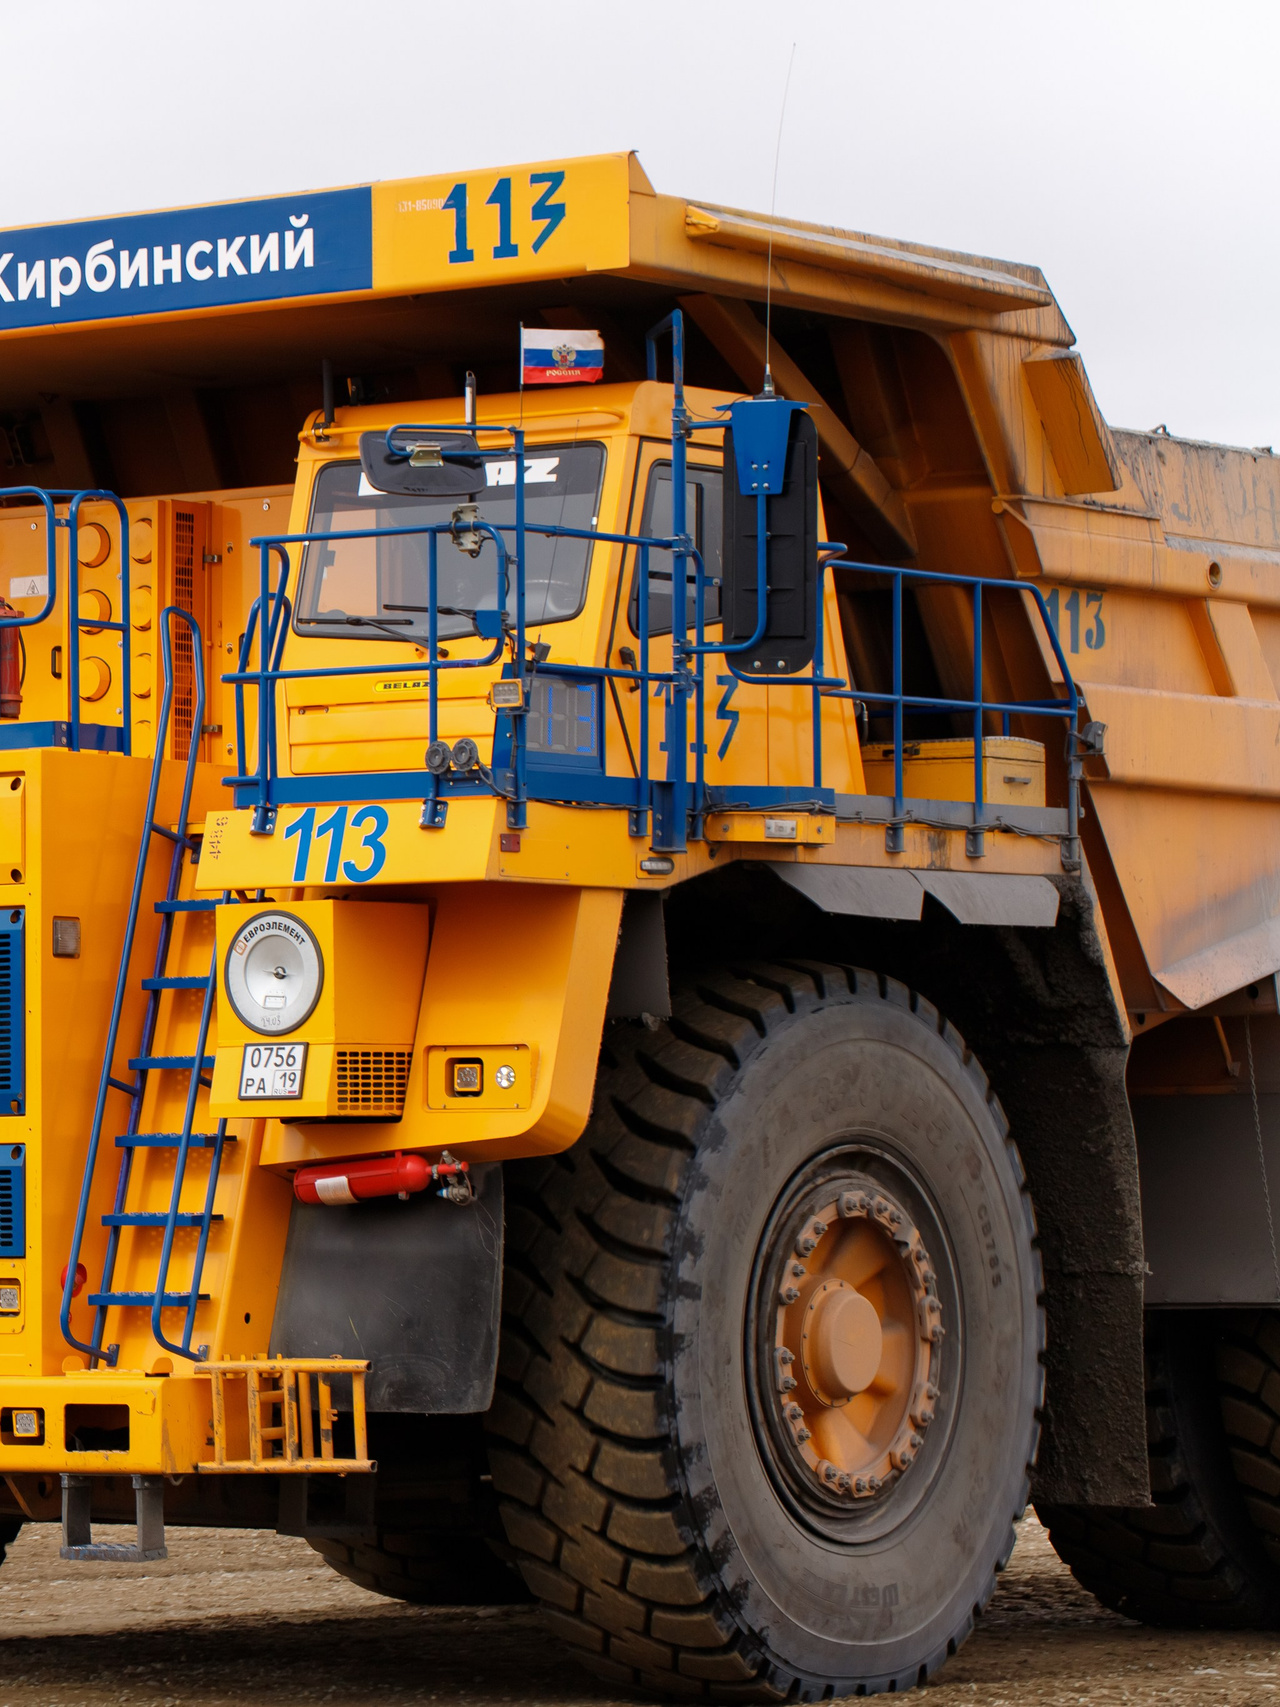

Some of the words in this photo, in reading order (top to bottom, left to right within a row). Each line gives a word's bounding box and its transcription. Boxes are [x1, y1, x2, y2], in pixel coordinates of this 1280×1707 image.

[441, 170, 567, 264] 113
[1044, 588, 1106, 654] 113
[283, 804, 389, 884] 113
[243, 921, 306, 946] ЕВРОЭЛЕМЕНТ
[250, 1046, 297, 1068] 0756
[279, 1071, 297, 1088] 19
[977, 1203, 1002, 1288] CB785
